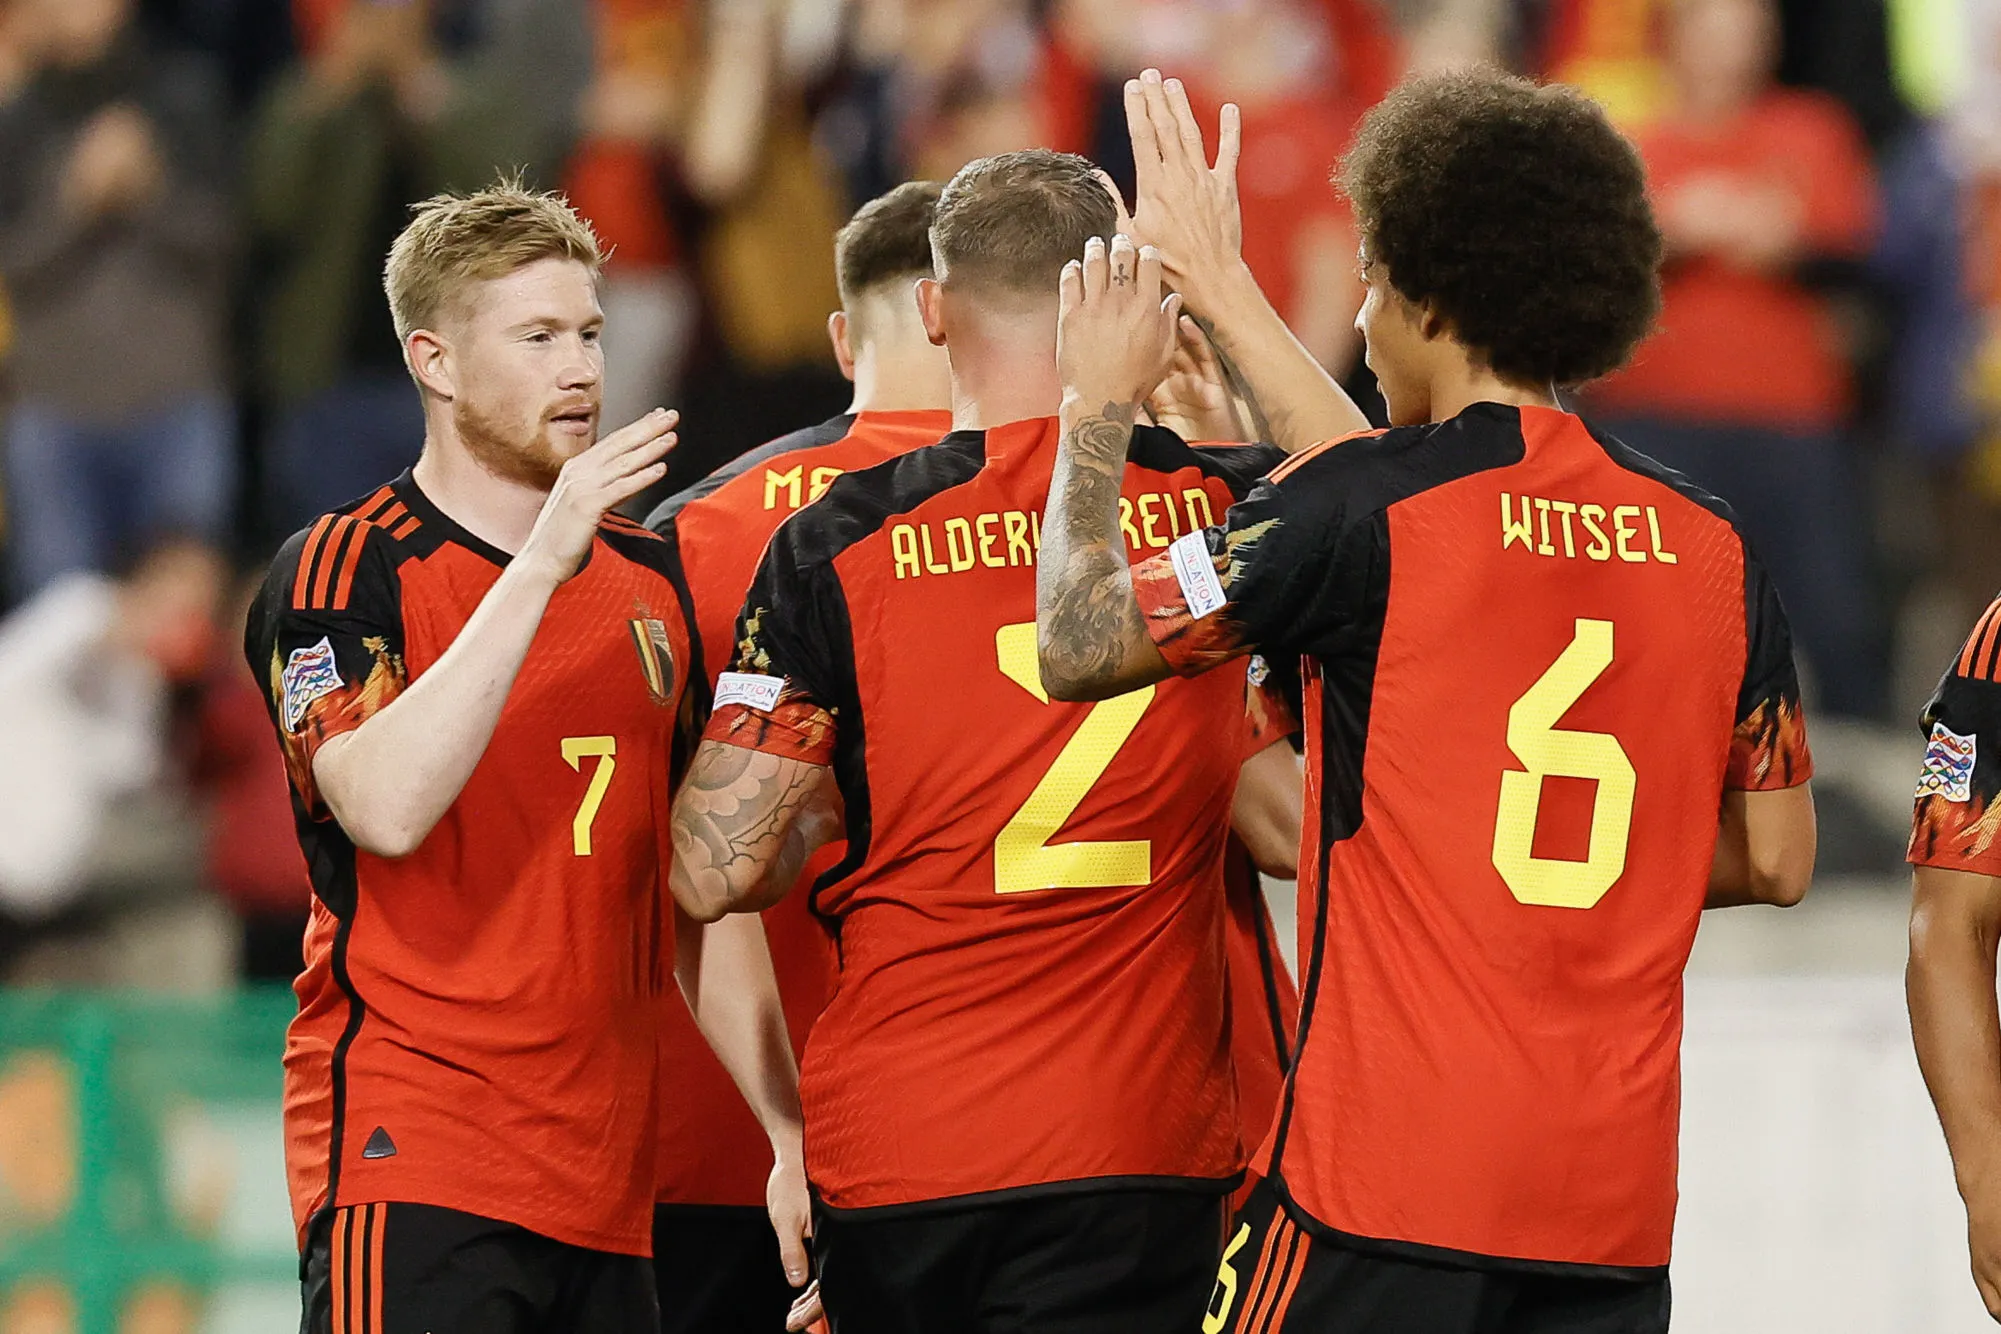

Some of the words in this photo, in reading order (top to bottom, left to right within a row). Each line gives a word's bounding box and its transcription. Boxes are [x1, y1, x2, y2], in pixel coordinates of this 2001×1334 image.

[890, 487, 1215, 581] ALDERRELD
[1500, 492, 1678, 564] WITSEL
[560, 735, 617, 857] 7
[994, 621, 1157, 894] 2
[1491, 618, 1637, 910] 6
